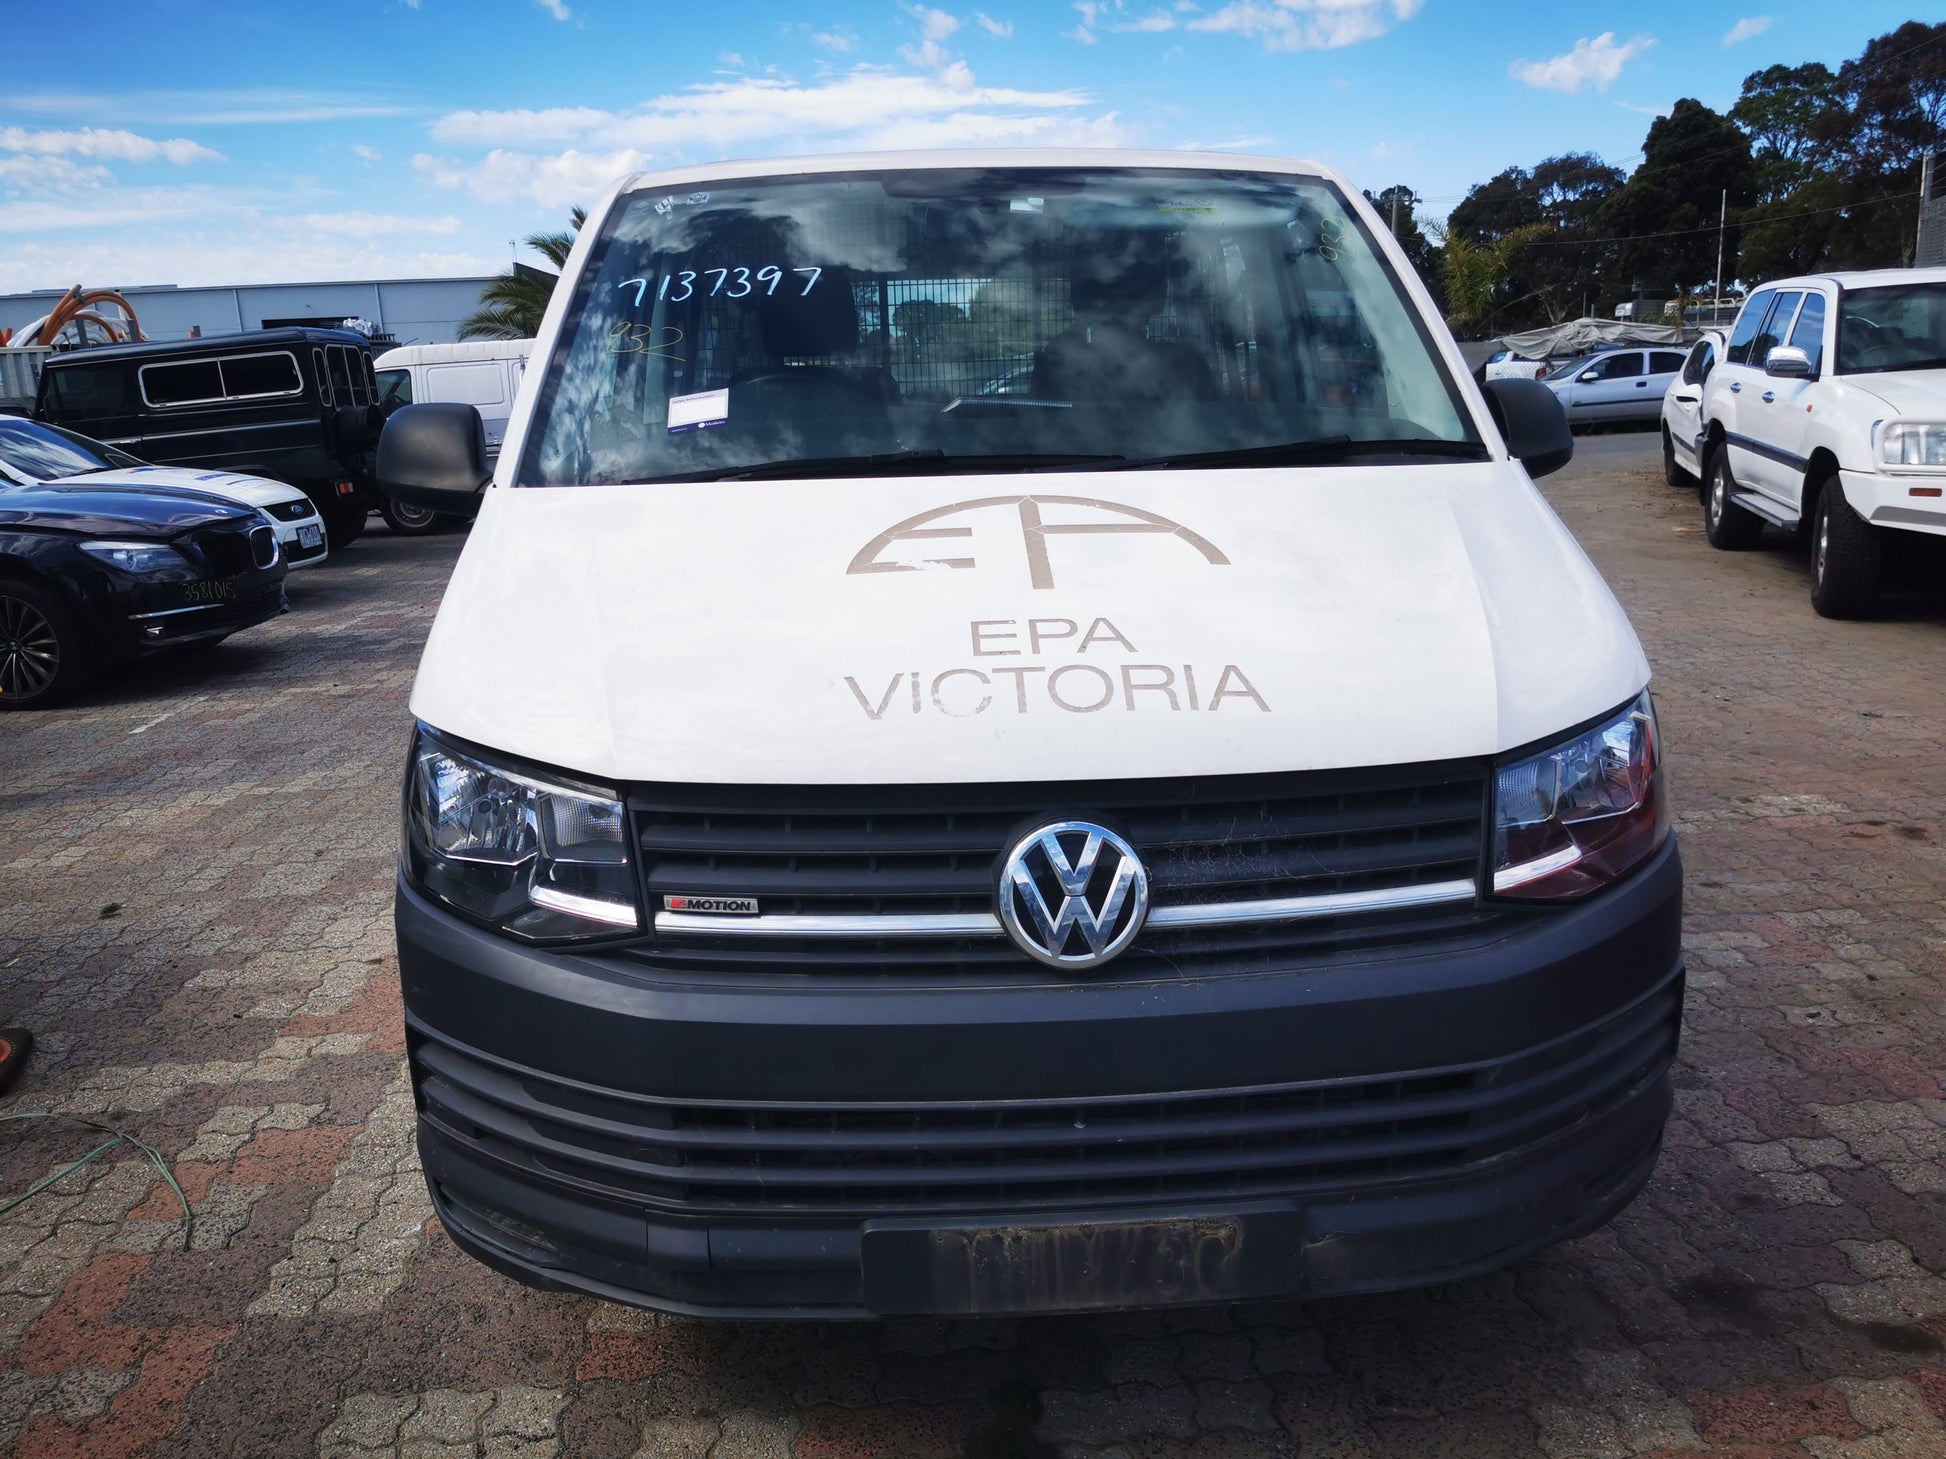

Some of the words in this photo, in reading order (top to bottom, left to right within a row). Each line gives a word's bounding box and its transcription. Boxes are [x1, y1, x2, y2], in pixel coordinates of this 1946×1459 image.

[618, 265, 822, 308] 7137397
[182, 580, 237, 601] 3581015
[970, 617, 1138, 656] EPA
[843, 664, 1272, 721] VICTORIA
